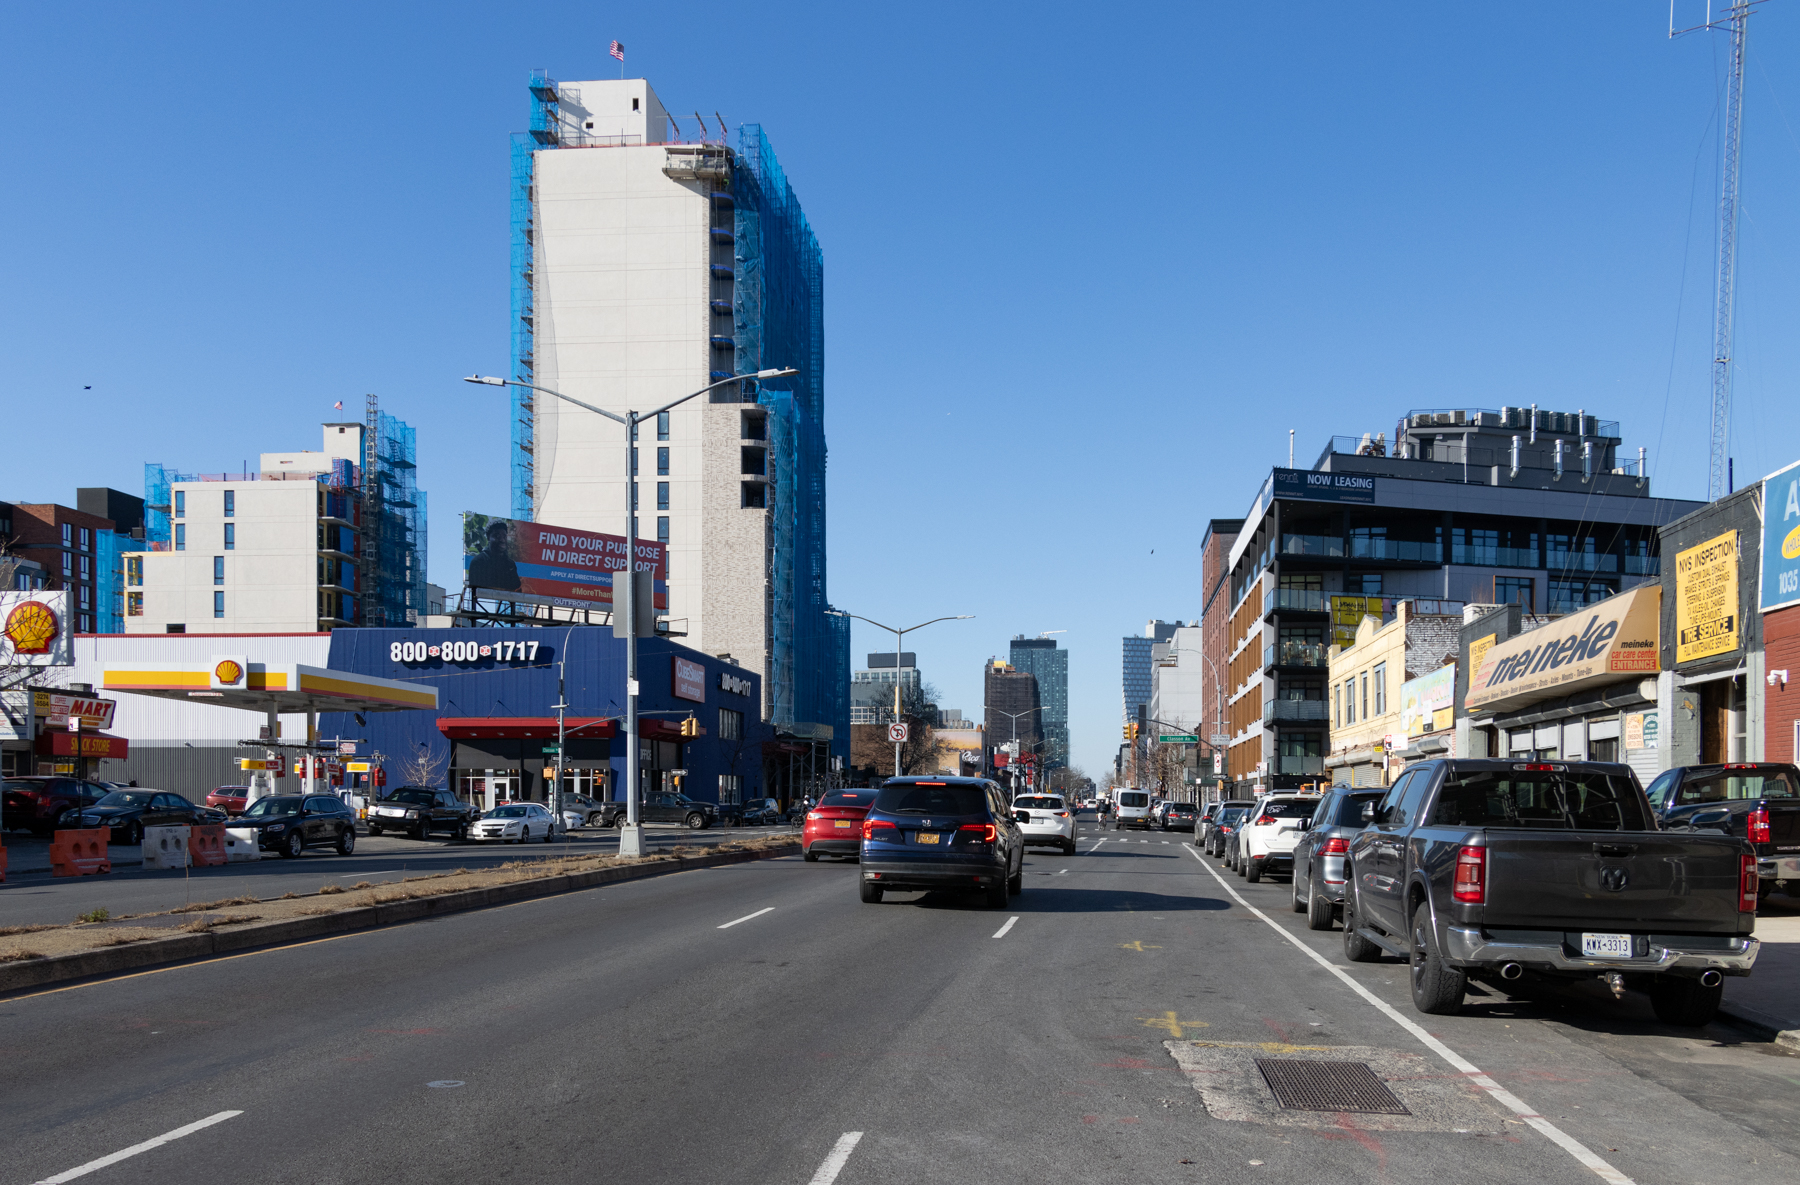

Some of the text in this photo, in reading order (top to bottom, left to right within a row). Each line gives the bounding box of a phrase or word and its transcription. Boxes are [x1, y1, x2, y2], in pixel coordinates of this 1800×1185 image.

[1307, 474, 1373, 488] NOW LEASING
[539, 532, 567, 546] FIND
[571, 536, 603, 552] YOUR
[542, 549, 658, 574] IN DIRECT SUPORT
[1679, 539, 1734, 574] NYS INSPECTION
[1712, 560, 1726, 575] EXHAUST
[575, 574, 613, 583] DIRECTSUPPOR
[1780, 569, 1798, 594] 1035
[572, 587, 613, 598] #MoreThan
[1685, 582, 1697, 595] BRAKES
[1706, 585, 1726, 600] SUSPENSION
[1699, 617, 1729, 640] SERVICE
[1621, 639, 1654, 649] meineke
[1715, 635, 1730, 650] SERVICE
[390, 641, 539, 662] 800 800 1717
[1486, 614, 1619, 688] meineke
[1612, 649, 1657, 659] car care center
[1612, 660, 1655, 670] ENTRANCE
[688, 686, 700, 698] storage
[70, 700, 112, 717] MART
[71, 738, 110, 752] SNCK STORE
[961, 751, 980, 762] Rico
[1587, 939, 1628, 951] KWX 3313
